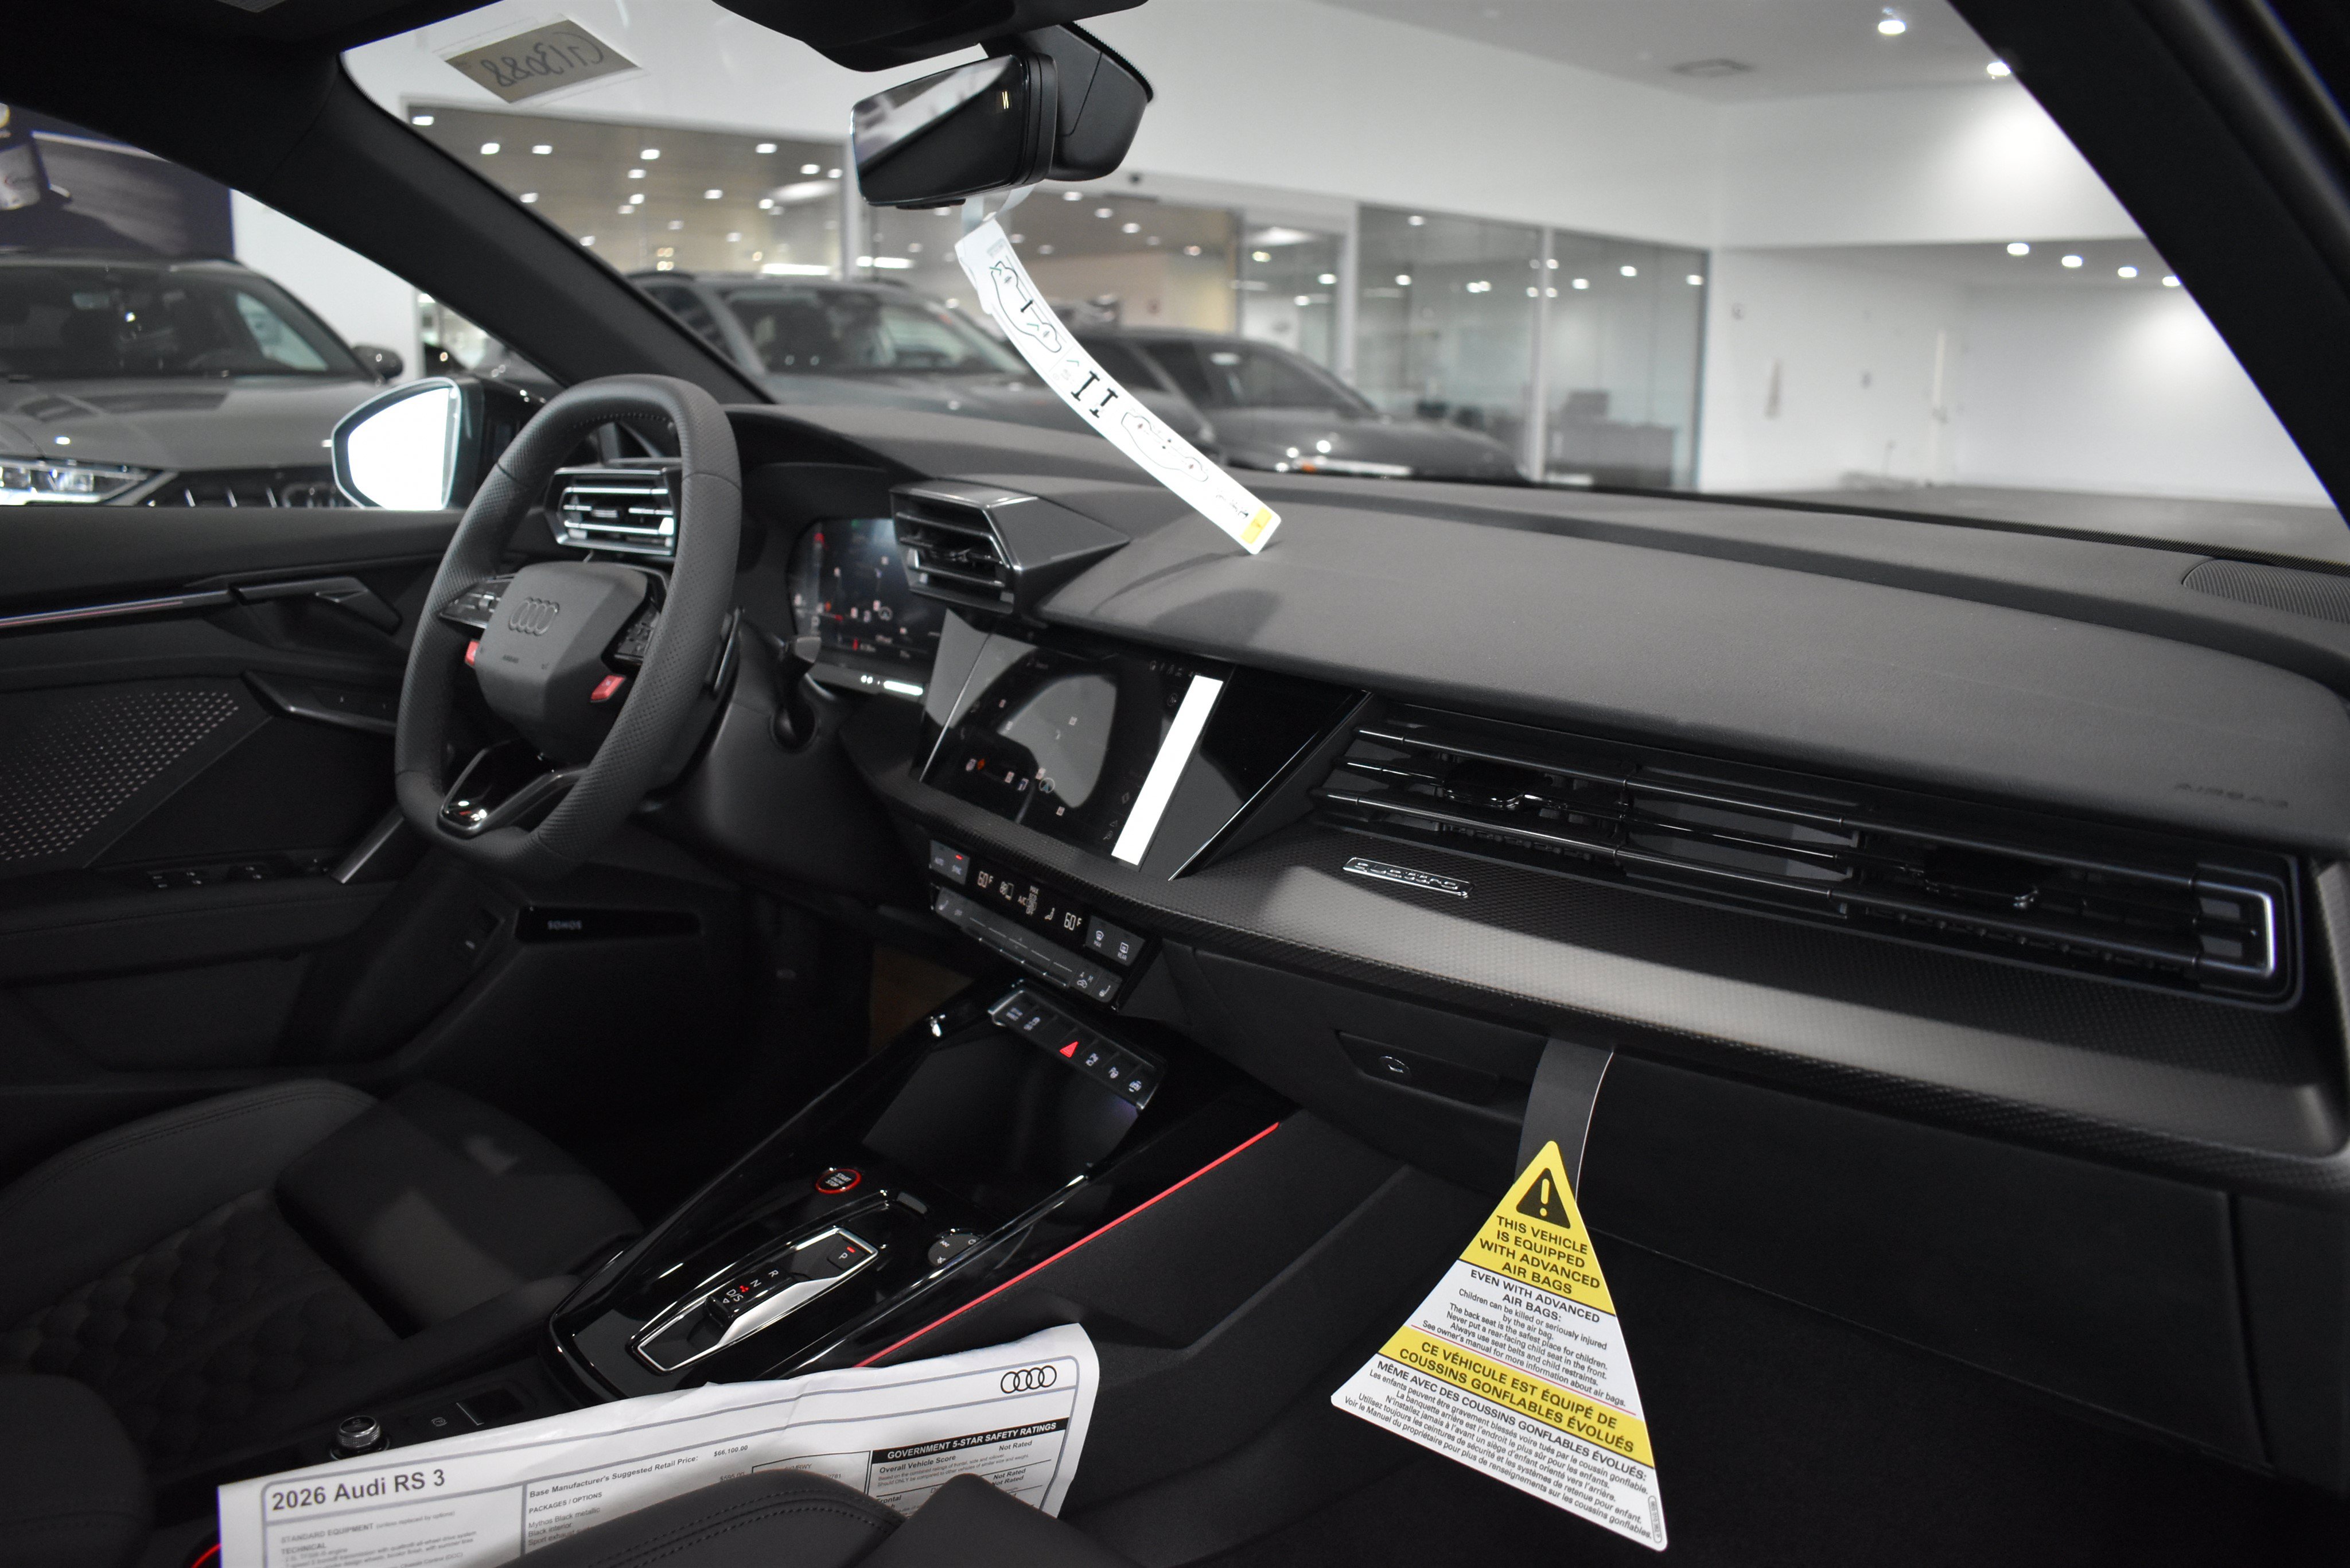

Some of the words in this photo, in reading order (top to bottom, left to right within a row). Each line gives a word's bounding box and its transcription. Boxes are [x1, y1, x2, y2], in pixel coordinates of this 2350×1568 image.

[1496, 1215, 1526, 1234] THIS
[1531, 1226, 1588, 1255] VEHICLE
[1496, 1230, 1509, 1242] IS
[1514, 1235, 1585, 1268] EQUIPPED
[750, 1279, 762, 1288] N
[768, 1270, 779, 1278] R
[1480, 1238, 1515, 1259] WITH
[1519, 1253, 1600, 1288] ADVANCED
[1501, 1262, 1527, 1278] AIR
[1531, 1271, 1571, 1294] BAGS
[1470, 1269, 1499, 1286] EVEN
[1503, 1281, 1532, 1298] WITH
[1535, 1294, 1600, 1322] ADVANCED
[1502, 1294, 1522, 1307] AIR
[1526, 1301, 1561, 1321] BAGS:
[1450, 1302, 1462, 1314] The
[1464, 1308, 1480, 1321] back
[1481, 1317, 1496, 1327] seat
[1497, 1321, 1504, 1329] is
[1505, 1325, 1517, 1334] the
[1518, 1331, 1540, 1344] safest
[1541, 1339, 1561, 1352] place
[1563, 1346, 1574, 1356] for
[1575, 1352, 1607, 1369] children.
[1458, 1288, 1488, 1305] Children
[1489, 1301, 1502, 1310] can
[1504, 1305, 1513, 1314] be
[1515, 1309, 1534, 1322] killed
[1545, 1322, 1579, 1340] seriously
[1580, 1333, 1607, 1350] injured
[1502, 1314, 1512, 1324] by
[1514, 1319, 1525, 1328] the
[1538, 1328, 1553, 1341] bag.
[1422, 1320, 1435, 1330] See
[1465, 1339, 1492, 1353] manual
[1493, 1348, 1504, 1357] for
[1505, 1354, 1524, 1366] more
[1526, 1361, 1569, 1383] information
[1570, 1380, 1592, 1393] about
[1593, 1389, 1604, 1397] air
[1605, 1392, 1625, 1406] bags.
[1446, 1310, 1468, 1324] Never
[1468, 1321, 1481, 1330] put
[1488, 1329, 1526, 1349] rear-facing
[1527, 1344, 1545, 1355] child
[1547, 1352, 1562, 1362] seat
[1564, 1356, 1571, 1365] in
[1573, 1361, 1585, 1371] the
[1587, 1365, 1606, 1379] front.
[1450, 1322, 1475, 1337] Always
[1477, 1334, 1489, 1343] use
[1491, 1339, 1506, 1349] seat
[1507, 1344, 1524, 1357] belts
[1526, 1353, 1540, 1363] and
[1542, 1359, 1560, 1371] child
[1562, 1367, 1597, 1386] restraints.
[1399, 1348, 1467, 1383] COUSSINS
[1471, 1378, 1563, 1423] GONFLABLES
[1566, 1415, 1633, 1452] ÉVOLUÉS
[1421, 1341, 1439, 1356] CE
[1442, 1349, 1507, 1384] VÉHICULE
[1511, 1377, 1538, 1395] EST
[1540, 1388, 1593, 1419] ÉQUIPÉ
[1597, 1412, 1617, 1429] DE
[887, 1441, 951, 1459] GOVERNMENT
[952, 1435, 983, 1448] 5-STAR
[985, 1429, 1018, 1442] SAFETY
[1020, 1422, 1056, 1435] RATINGS
[1369, 1369, 1381, 1379] Les
[1382, 1376, 1407, 1391] enfants
[1407, 1387, 1435, 1403] peuvent
[1436, 1398, 1450, 1409] être
[1451, 1406, 1489, 1426] gravement
[1490, 1421, 1517, 1438] blessés
[1519, 1434, 1537, 1446] voire
[1539, 1442, 1555, 1454] tués
[1555, 1451, 1569, 1460] par
[1570, 1455, 1577, 1464] le
[1579, 1461, 1608, 1477] coussin
[1609, 1474, 1647, 1494] gonflable.
[1377, 1360, 1409, 1380] MÊME
[1410, 1375, 1437, 1392] AVEC
[1439, 1387, 1460, 1402] DES
[1461, 1396, 1515, 1425] COUSSINS
[1518, 1421, 1589, 1456] GONFLABLES
[1592, 1450, 1646, 1481] ÉVOLUÉS:
[1396, 1390, 1404, 1399] La
[1406, 1393, 1439, 1414] banquette
[1441, 1411, 1464, 1425] arrière
[1465, 1422, 1476, 1430] est
[1508, 1439, 1515, 1448] le
[1516, 1444, 1532, 1455] plus
[1534, 1452, 1546, 1460] sûr
[1547, 1457, 1565, 1468] pour
[1566, 1464, 1578, 1474] les
[1579, 1471, 1609, 1488] enfants.
[530, 1489, 549, 1497] Base
[552, 1476, 609, 1492] Manufacturer's
[612, 1465, 652, 1479] Suggested
[655, 1460, 675, 1470] Retail
[677, 1456, 698, 1465] Price:
[714, 1445, 748, 1457] $66,100.00
[879, 1464, 906, 1473] Overall
[908, 1459, 933, 1469] Vehicle
[935, 1455, 956, 1464] Score
[1012, 1439, 1032, 1449] Rated
[1006, 1468, 1026, 1477] Rated
[273, 1487, 325, 1510] 2026
[334, 1478, 385, 1501] Audi
[395, 1472, 425, 1492] RS
[433, 1469, 444, 1486] 3
[1004, 1474, 1024, 1484] Rated
[529, 1500, 566, 1513] PACKAGES
[572, 1492, 602, 1503] OPTIONS
